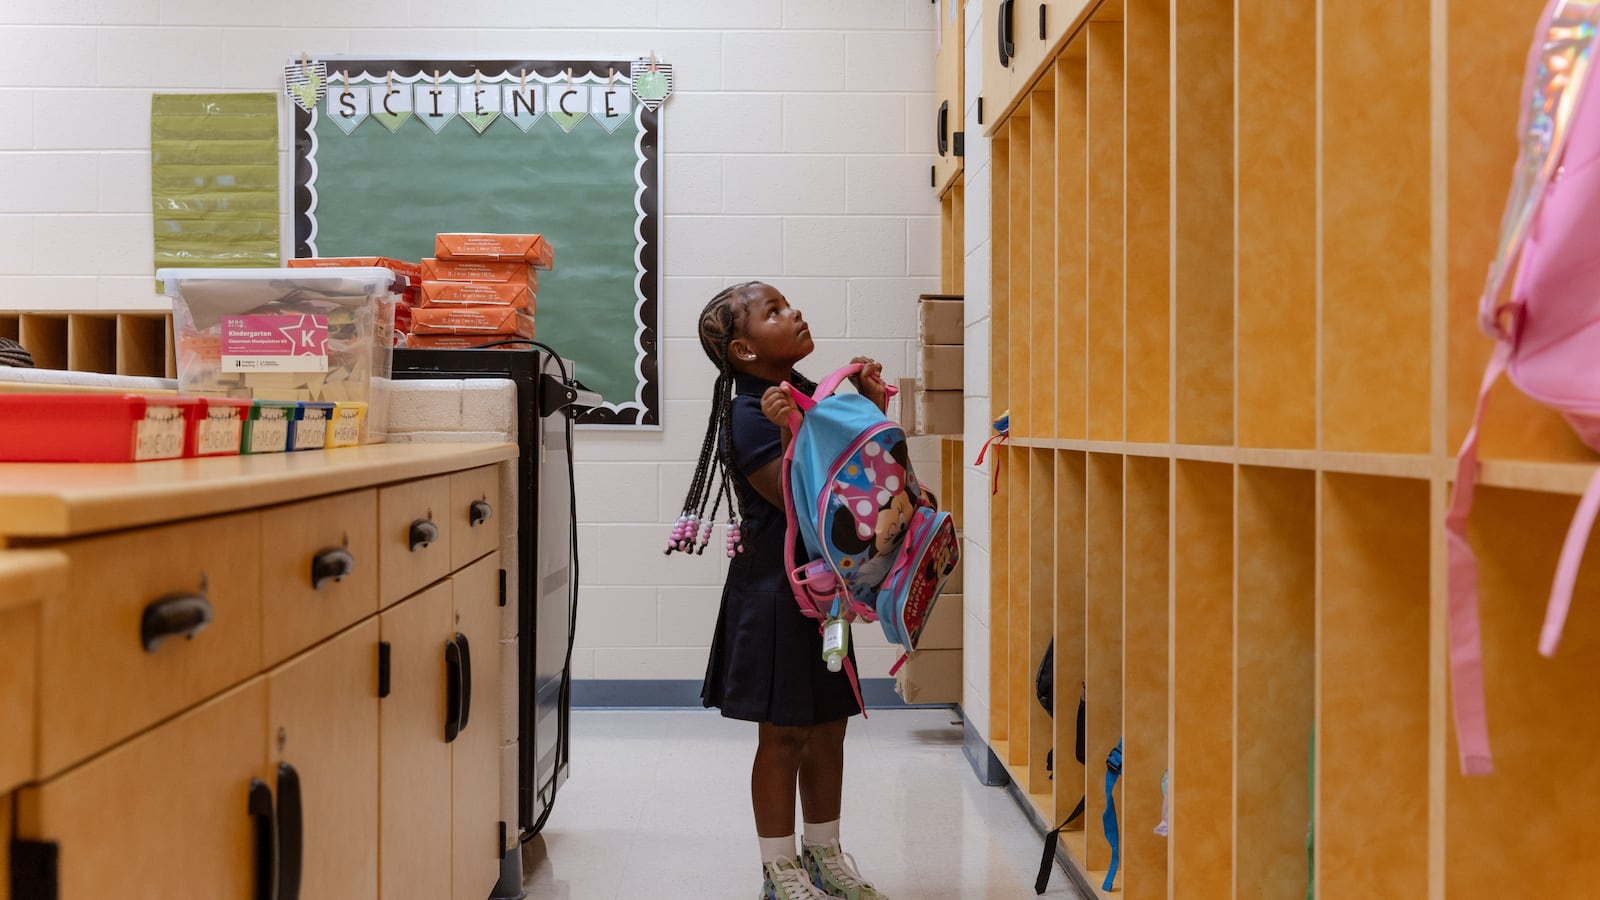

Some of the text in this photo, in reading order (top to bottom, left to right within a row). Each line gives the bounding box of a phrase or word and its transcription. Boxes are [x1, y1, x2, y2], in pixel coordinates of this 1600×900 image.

[339, 89, 619, 119] SCIENCE
[228, 330, 272, 338] Kindergarten
[301, 329, 316, 348] K
[911, 580, 926, 617] HAPPY
